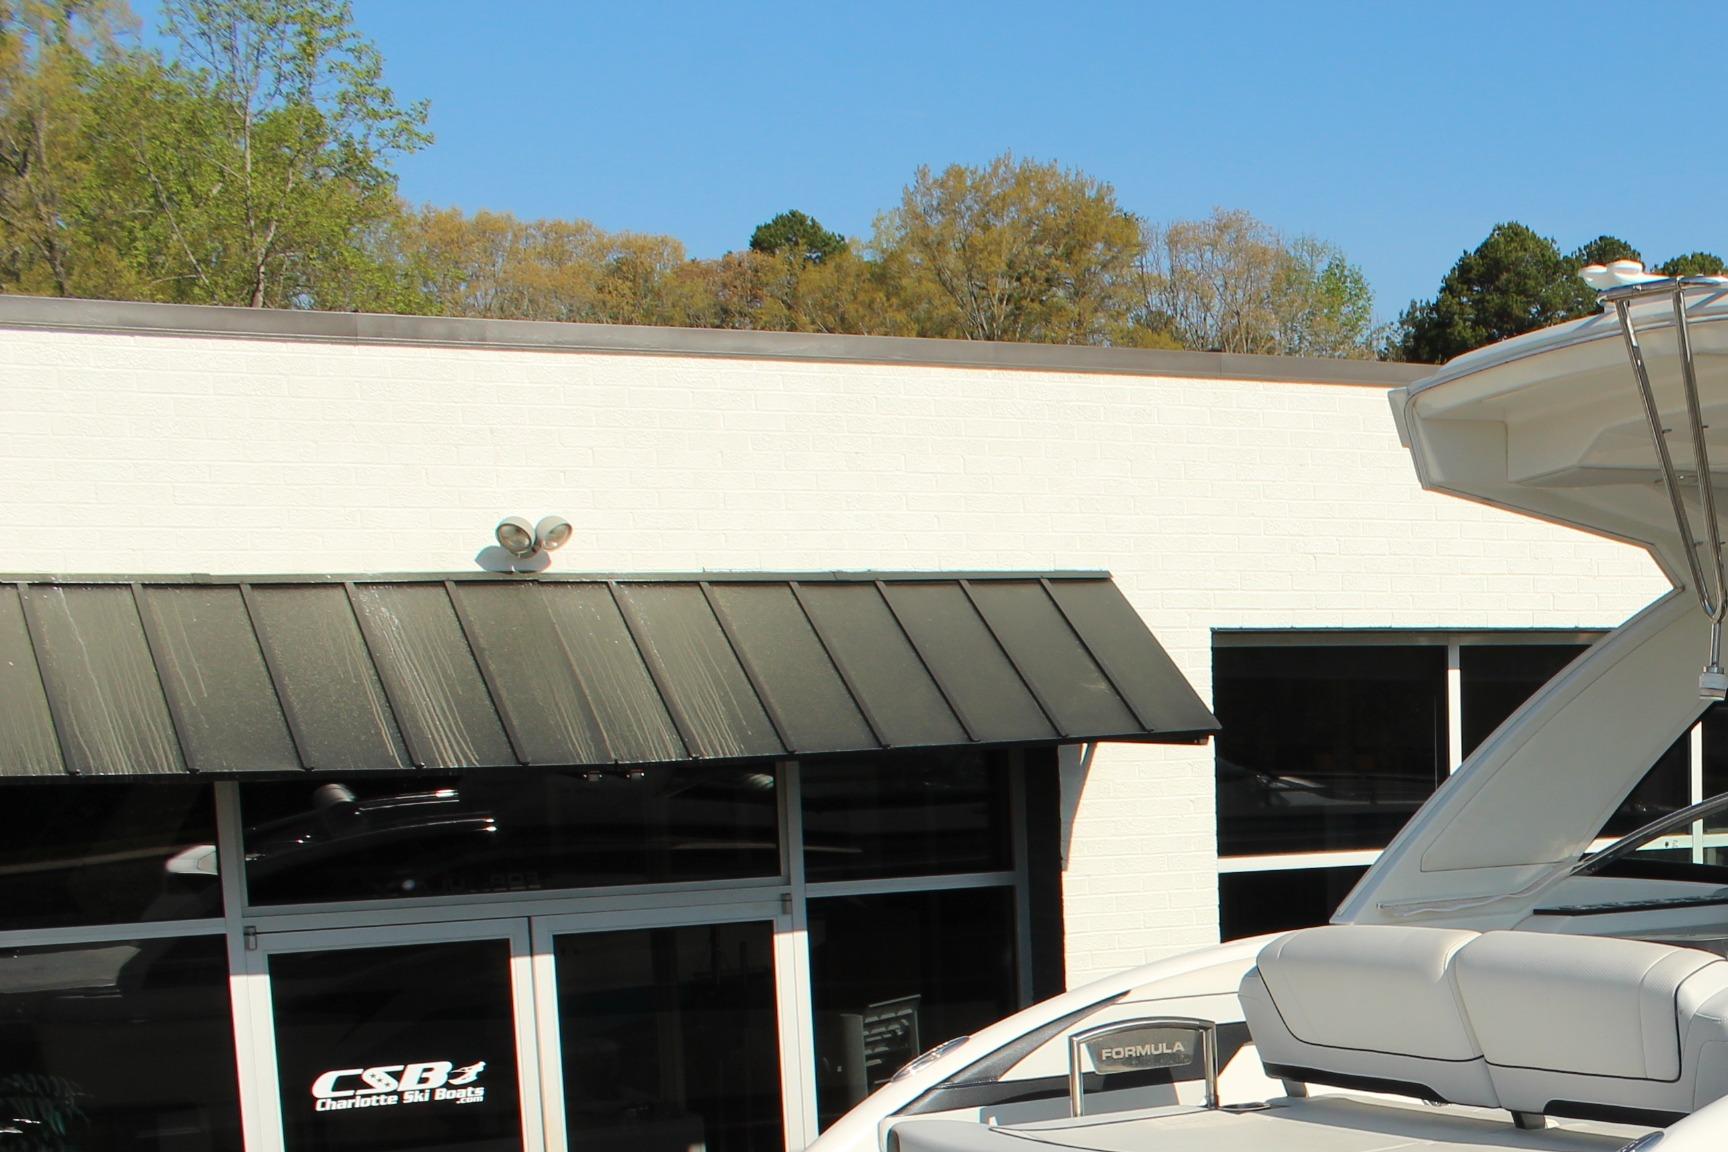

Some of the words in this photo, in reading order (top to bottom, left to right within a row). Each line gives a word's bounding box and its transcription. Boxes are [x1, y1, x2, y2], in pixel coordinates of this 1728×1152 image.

[1101, 1039, 1186, 1061] FORMULA
[311, 1061, 452, 1098] CSB
[316, 1092, 398, 1112] Charlotte
[403, 1089, 430, 1104] Ski
[434, 1086, 485, 1101] Boats
[456, 1094, 484, 1105] .com
